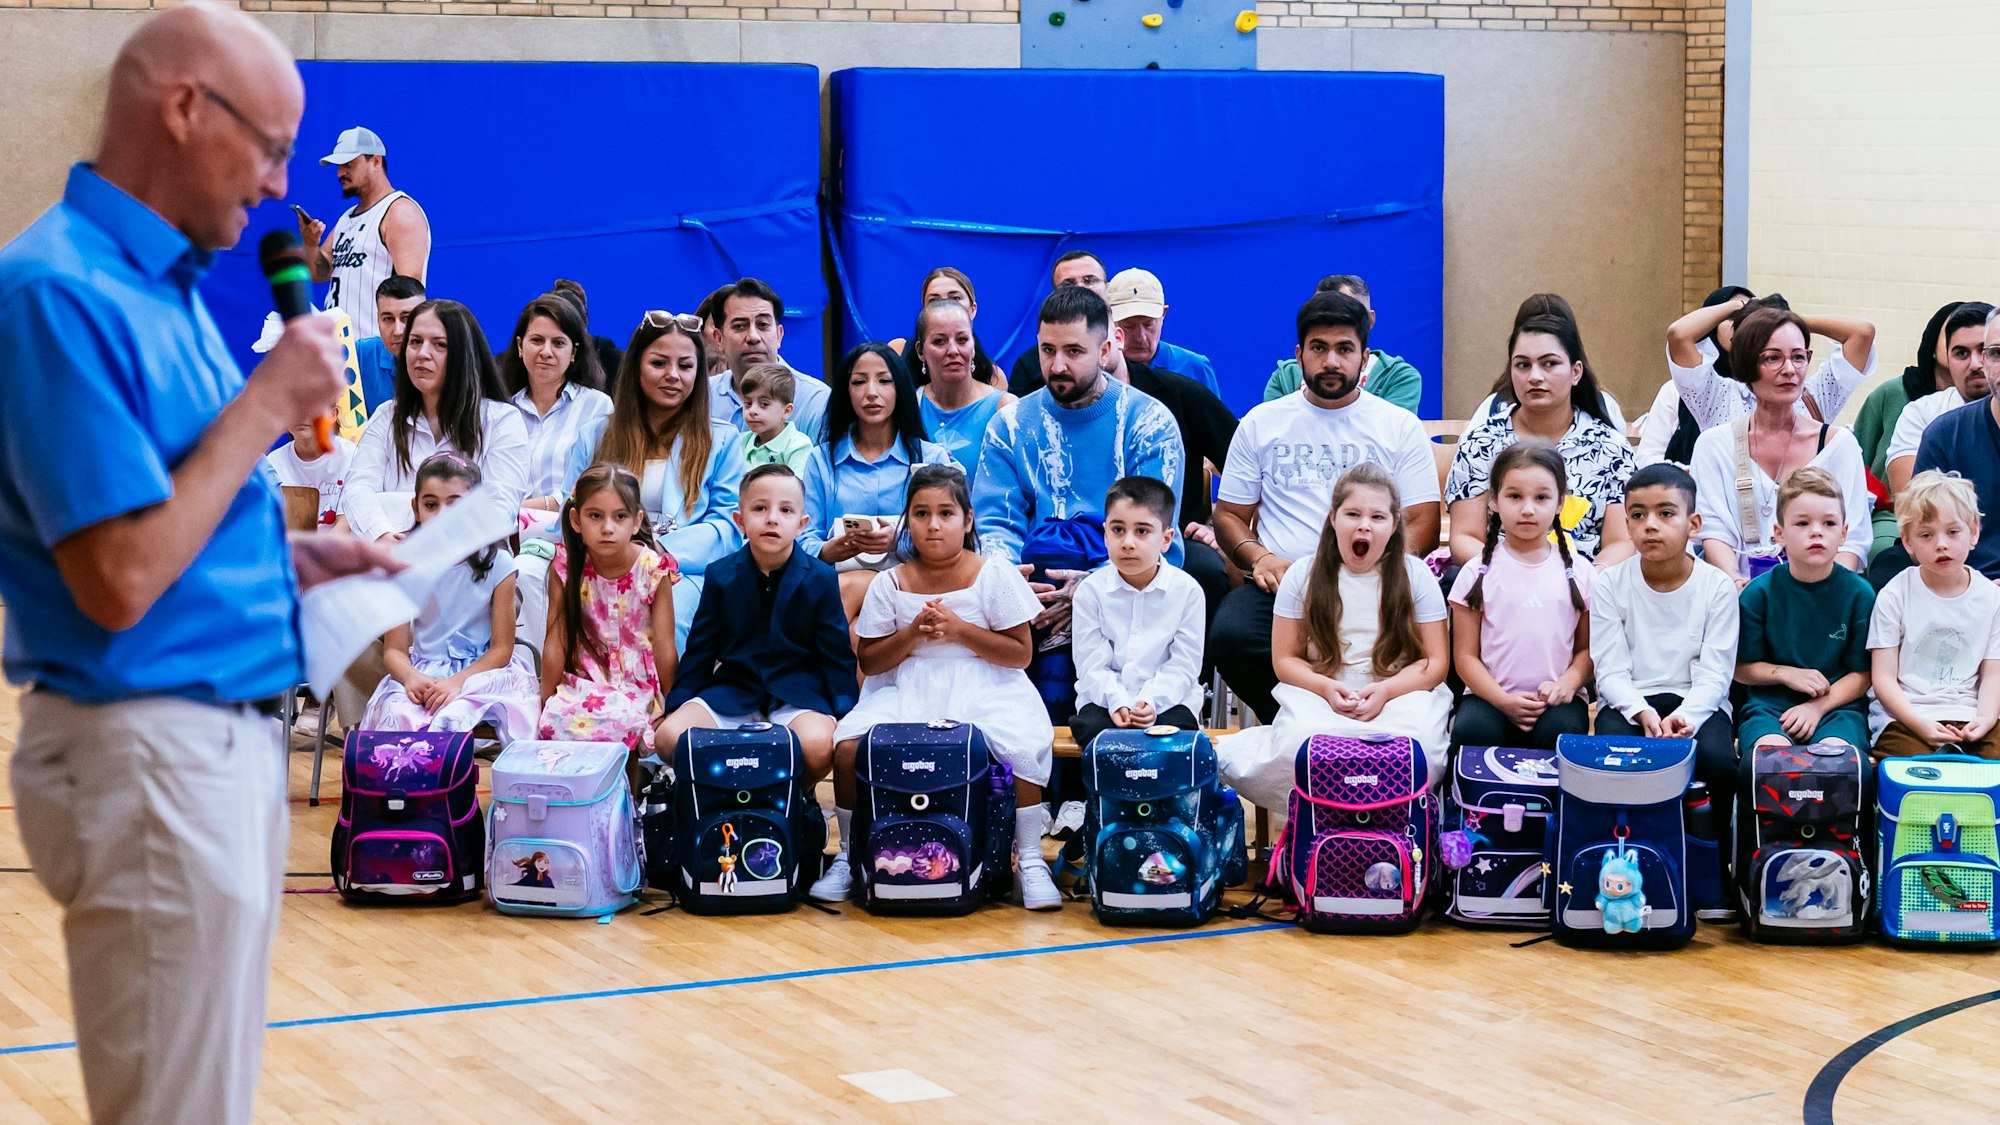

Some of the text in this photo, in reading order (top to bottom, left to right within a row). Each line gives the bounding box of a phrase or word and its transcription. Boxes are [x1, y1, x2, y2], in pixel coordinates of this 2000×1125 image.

[1272, 443, 1381, 476] PRADA
[726, 757, 759, 769] ergobag
[902, 760, 935, 772] ergobag
[1125, 768, 1158, 780] ergobag
[1344, 774, 1378, 786] ergobag
[1788, 789, 1824, 801] ergobag
